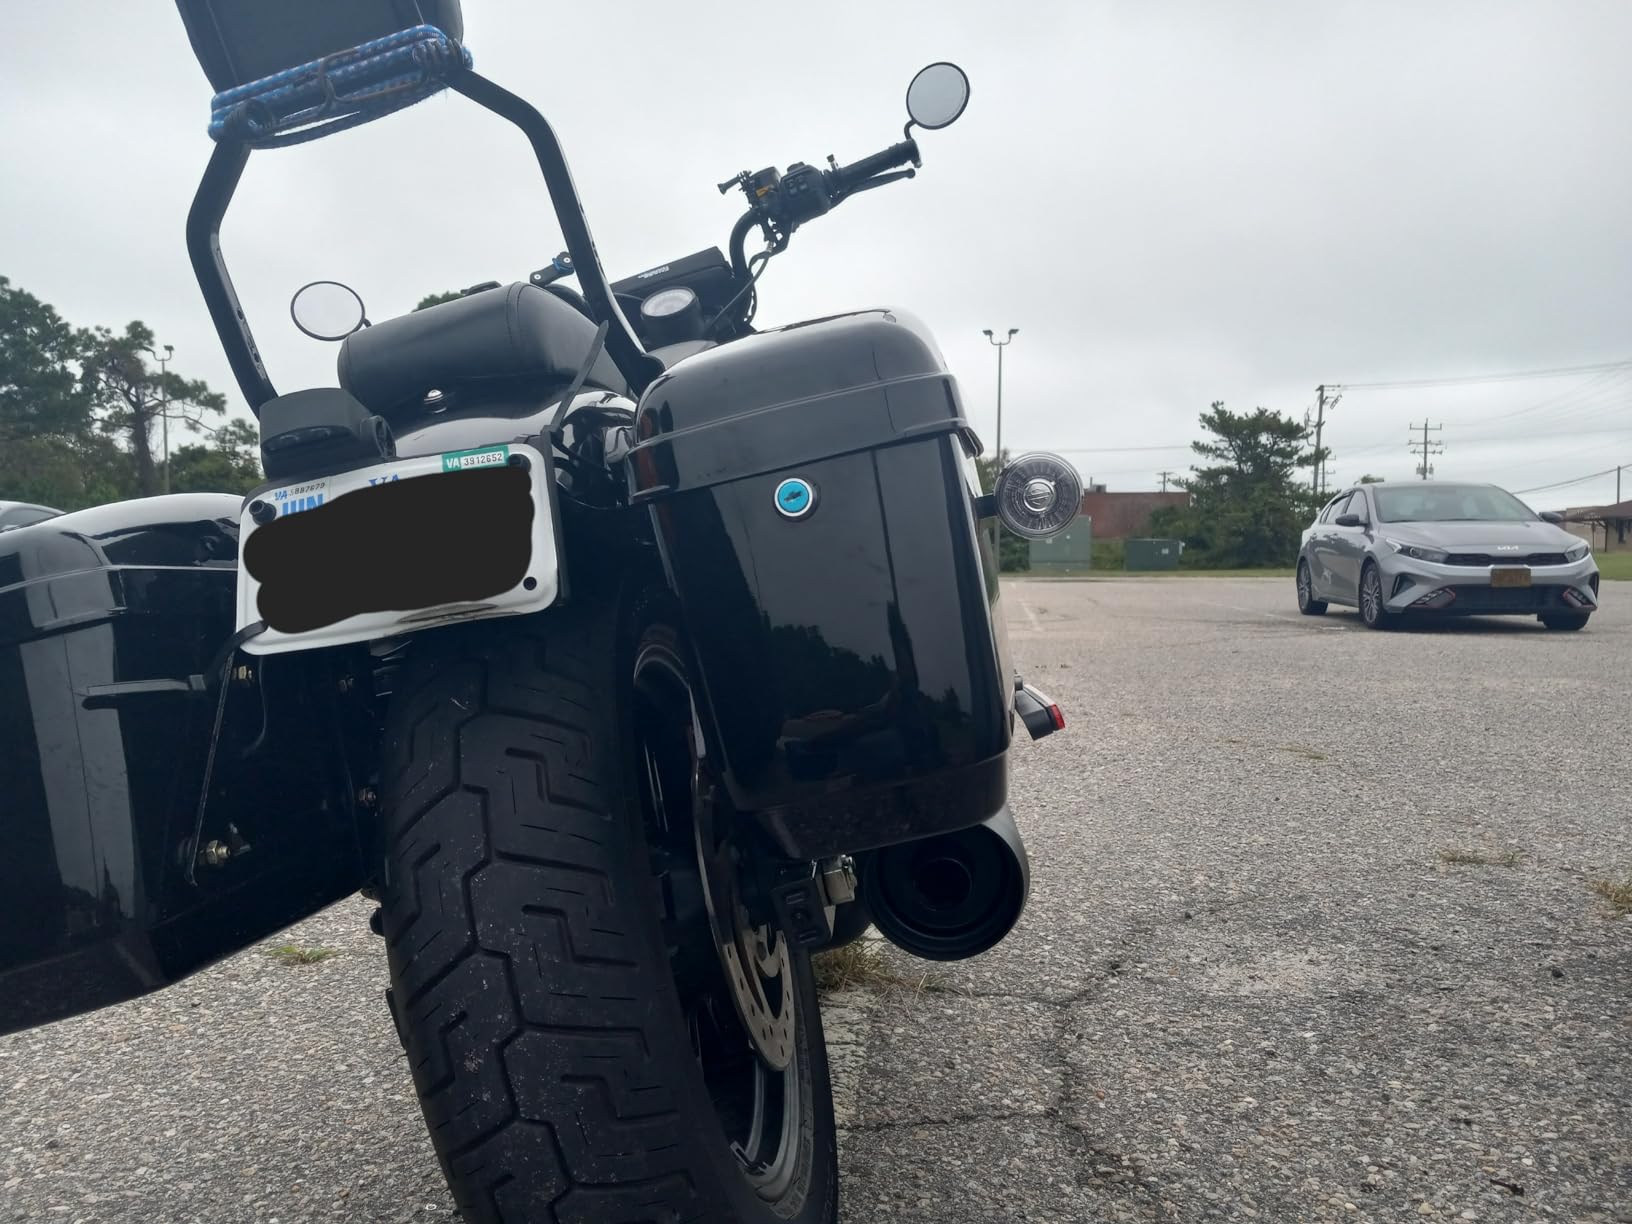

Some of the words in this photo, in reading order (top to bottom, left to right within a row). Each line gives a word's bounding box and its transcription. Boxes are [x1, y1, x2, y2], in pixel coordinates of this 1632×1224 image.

[446, 457, 460, 469] VA
[464, 453, 503, 466] 3912652
[274, 490, 288, 501] VA
